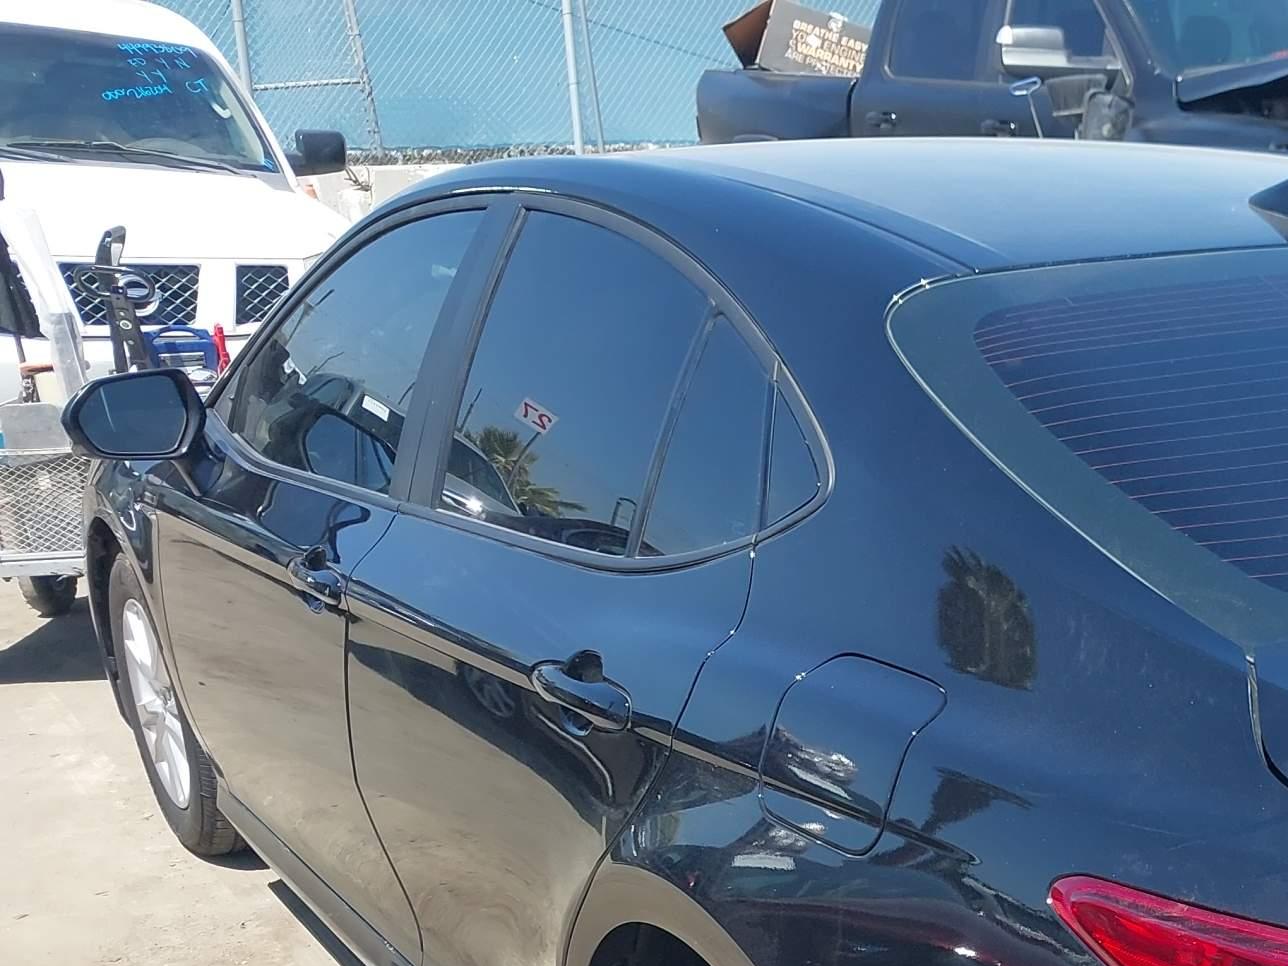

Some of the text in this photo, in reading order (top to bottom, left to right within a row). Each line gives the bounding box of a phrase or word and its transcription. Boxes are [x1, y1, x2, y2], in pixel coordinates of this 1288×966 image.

[792, 20, 869, 52] BREATHE EASY
[797, 42, 864, 72] WARRANTY
